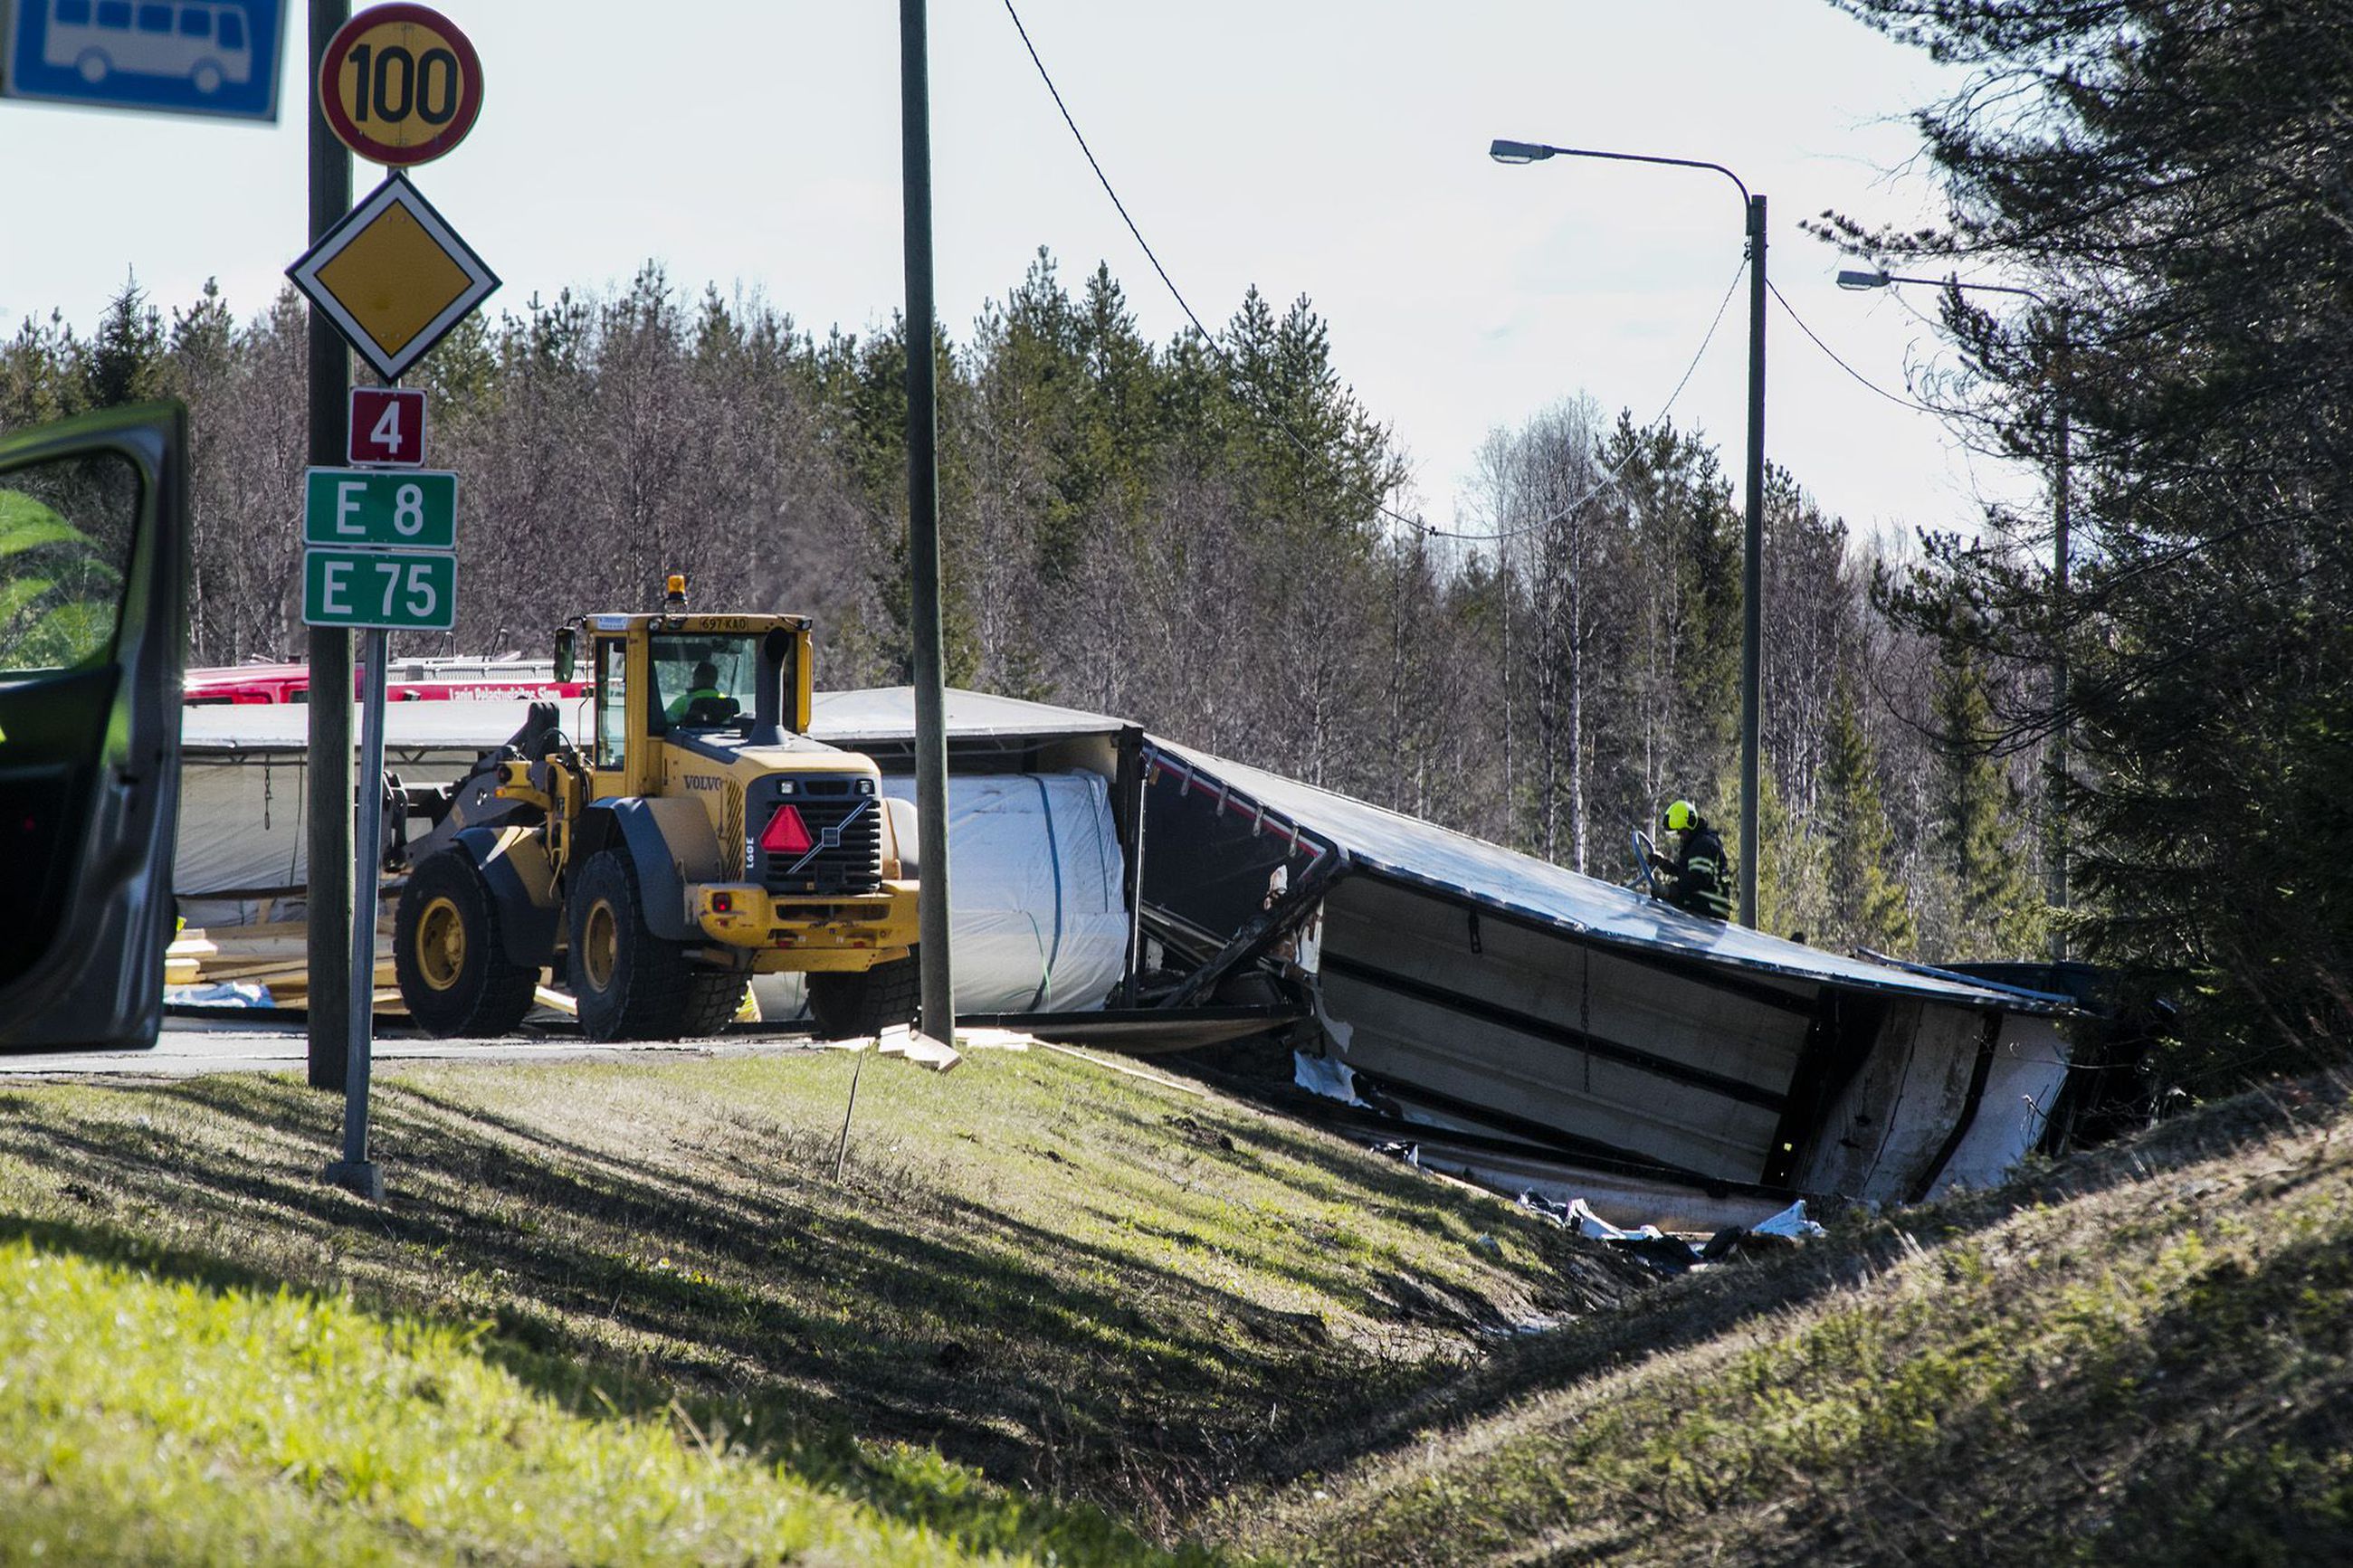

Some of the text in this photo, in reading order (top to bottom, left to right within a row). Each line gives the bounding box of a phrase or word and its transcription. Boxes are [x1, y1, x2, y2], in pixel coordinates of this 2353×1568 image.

[348, 43, 458, 125] 100
[370, 401, 403, 454] 4
[337, 481, 424, 536] E 8
[323, 561, 436, 617] E 75
[683, 774, 723, 791] VOLVO
[746, 837, 754, 869] L60E
